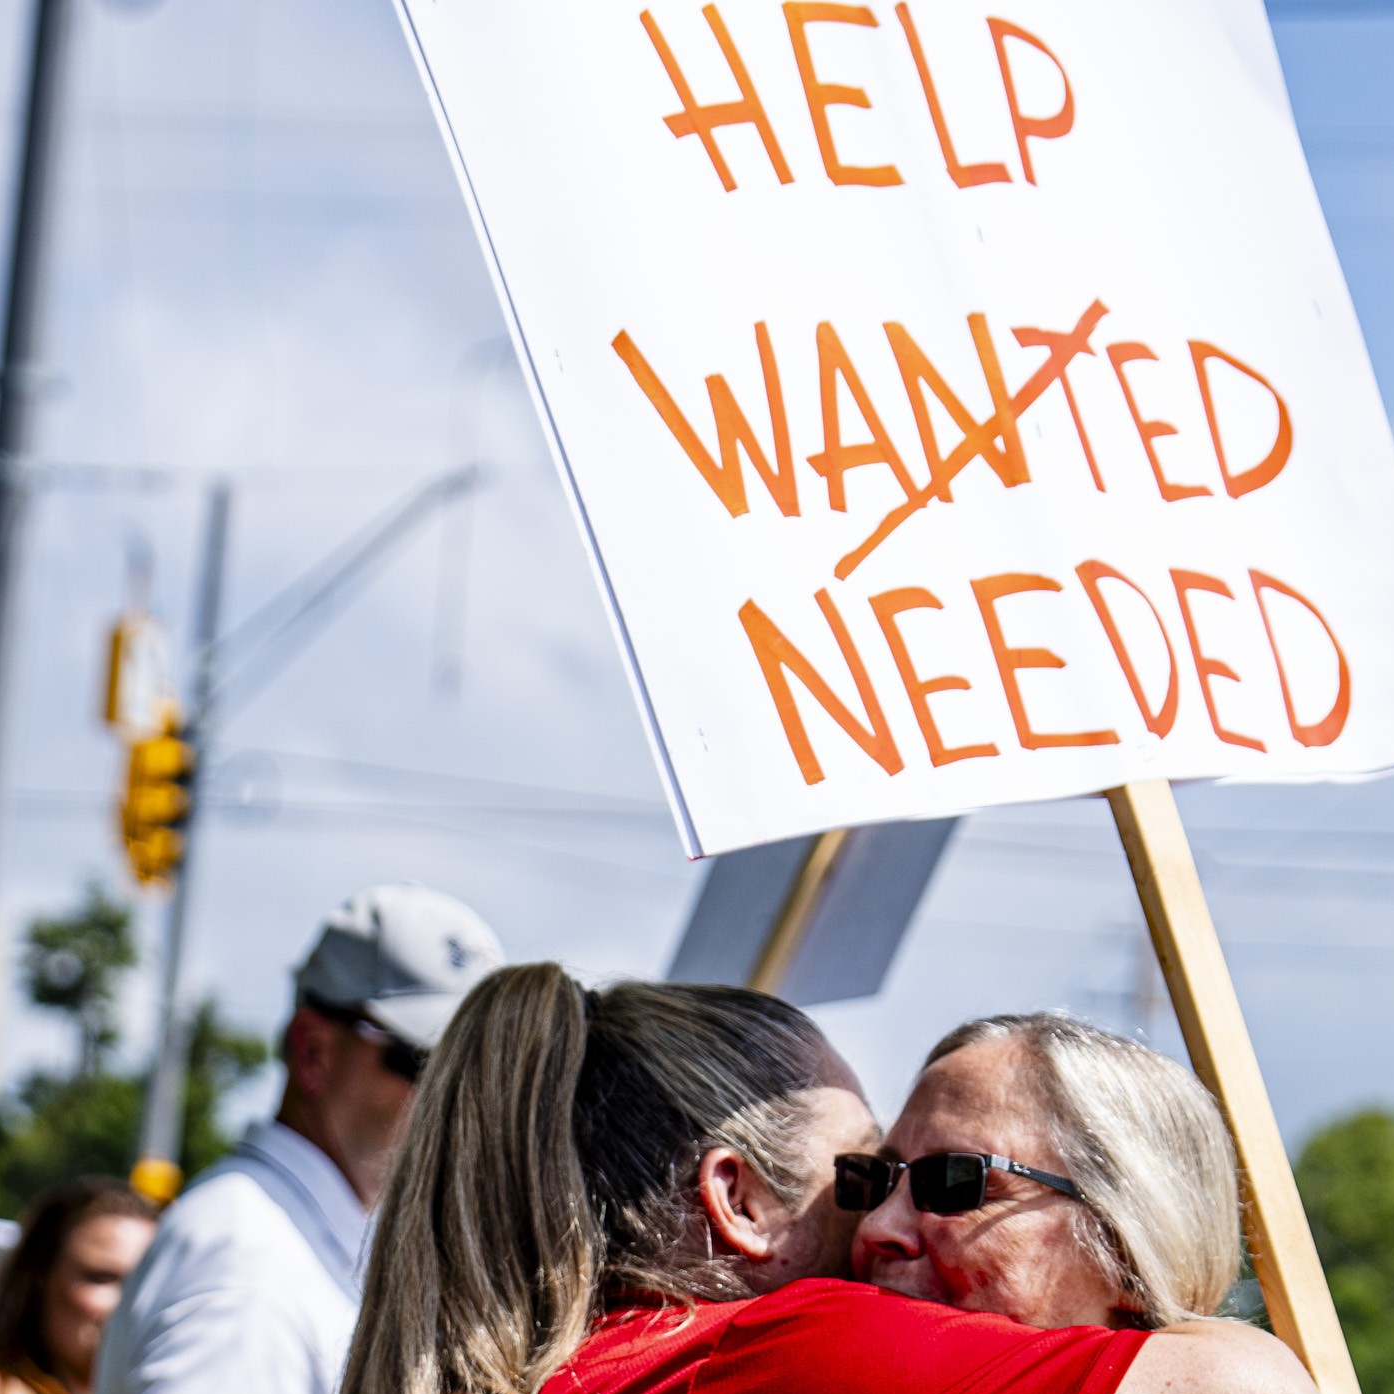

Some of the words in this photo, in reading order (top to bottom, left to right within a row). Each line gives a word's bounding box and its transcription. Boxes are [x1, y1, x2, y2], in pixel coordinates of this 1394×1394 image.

[639, 1, 1075, 193] HELP
[612, 300, 1293, 580] WANTED
[738, 560, 1350, 785] NEEDED
